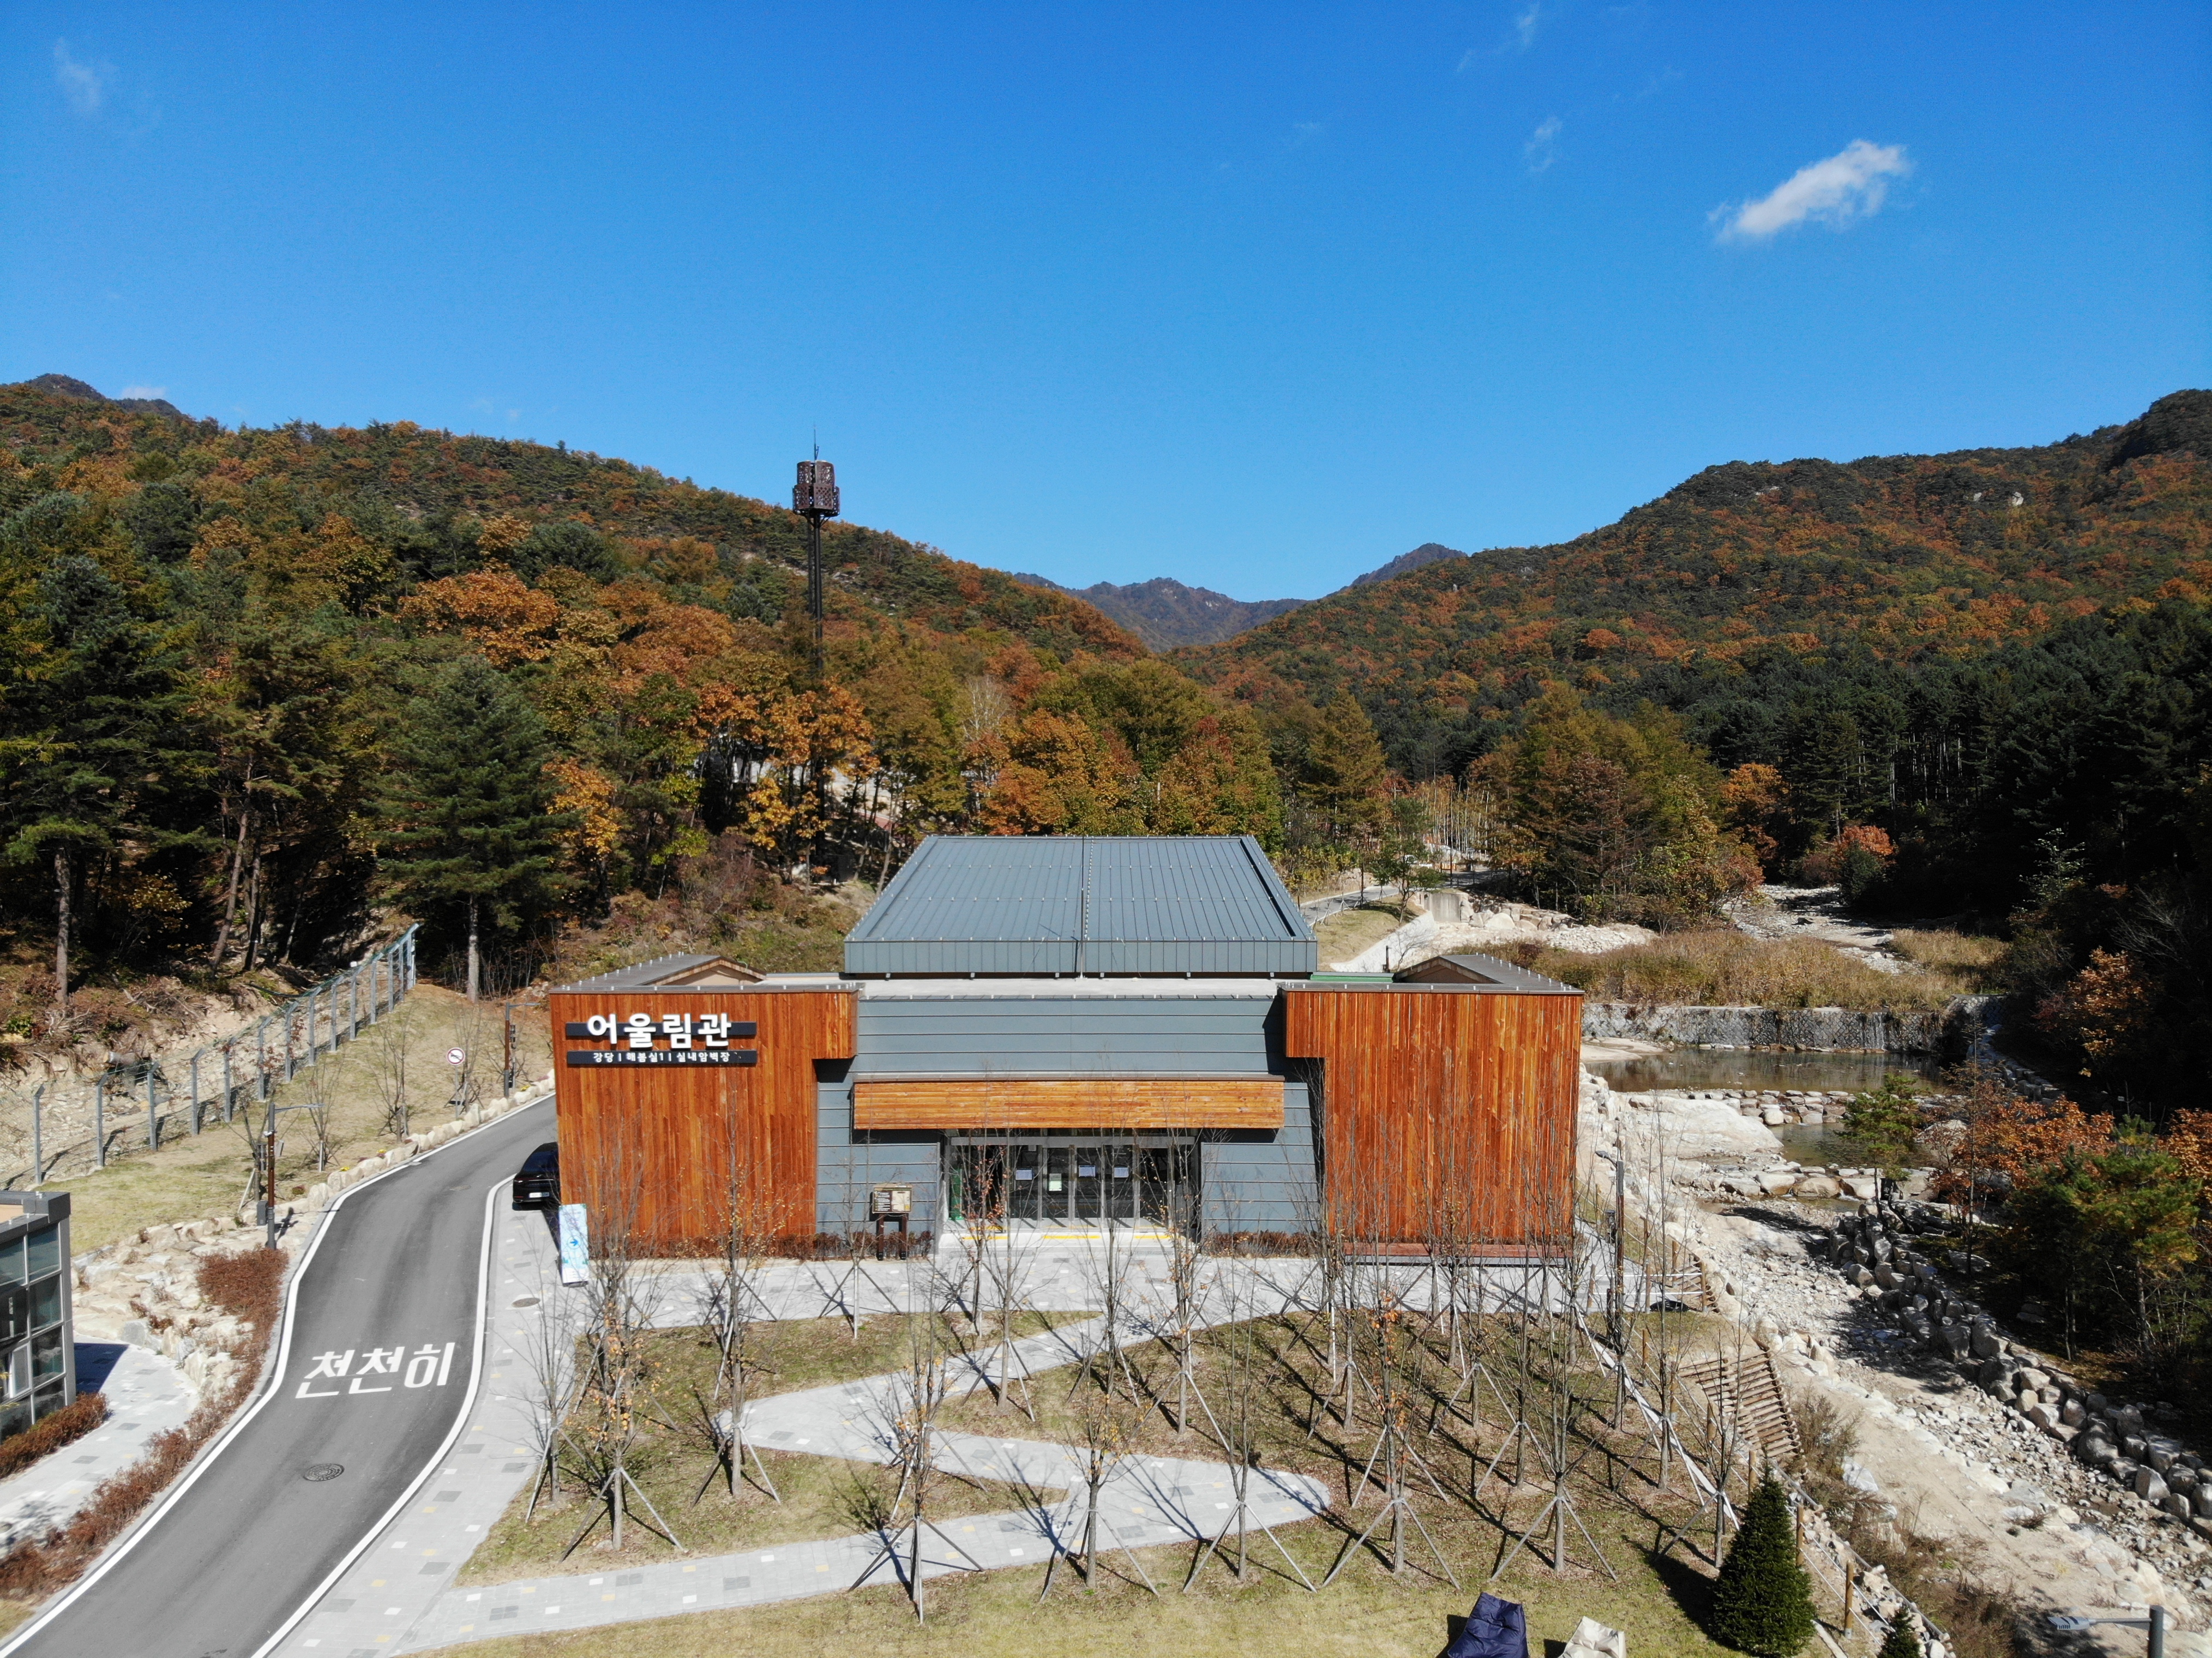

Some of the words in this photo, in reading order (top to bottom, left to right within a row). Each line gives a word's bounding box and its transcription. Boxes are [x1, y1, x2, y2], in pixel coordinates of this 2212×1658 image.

[587, 1012, 731, 1049] 어울림관
[593, 1052, 614, 1062] 강당
[677, 1052, 730, 1062] 실내암벽장
[295, 1342, 455, 1398] 천천히
